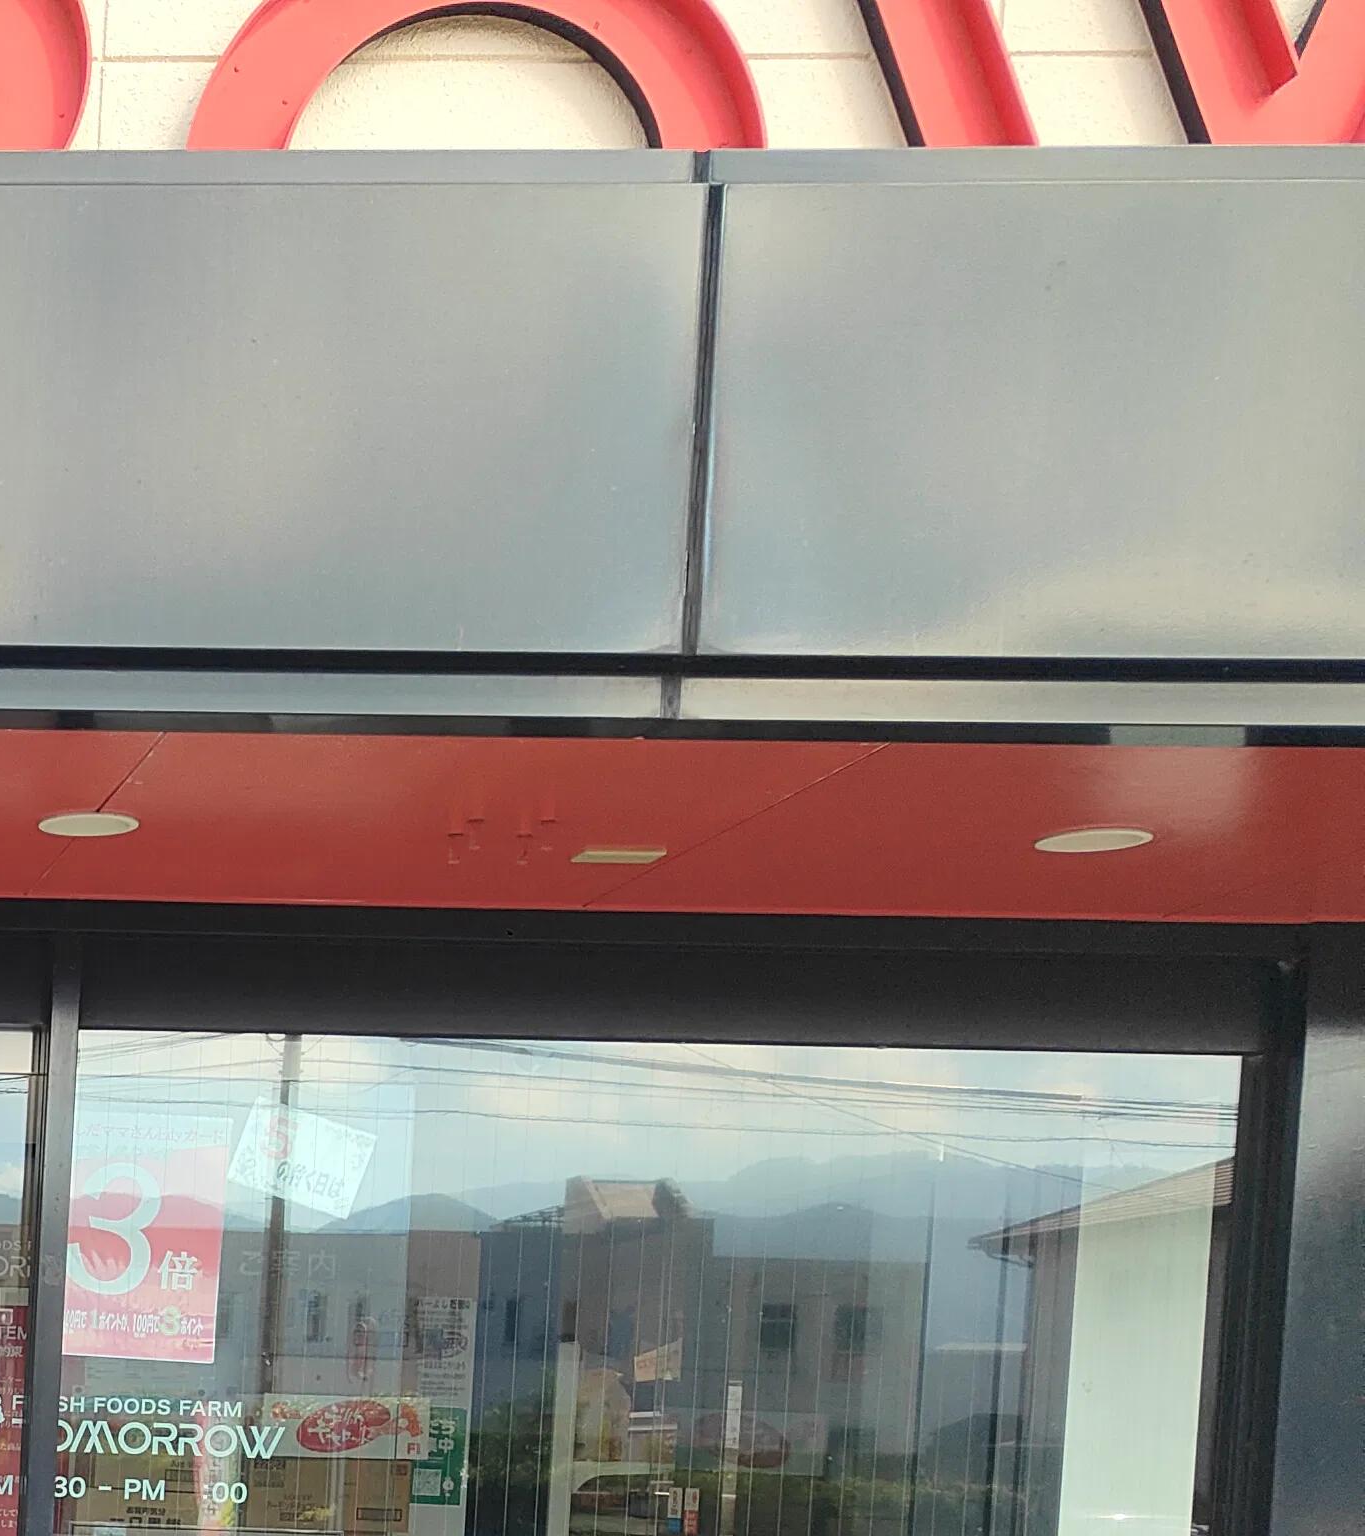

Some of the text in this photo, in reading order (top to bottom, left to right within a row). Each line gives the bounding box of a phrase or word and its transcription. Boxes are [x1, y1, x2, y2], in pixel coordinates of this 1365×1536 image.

[93, 1396, 171, 1417] FOODS
[179, 1400, 243, 1419] FARM
[11, 1418, 286, 1460] MORROW
[123, 1478, 167, 1502] PM
